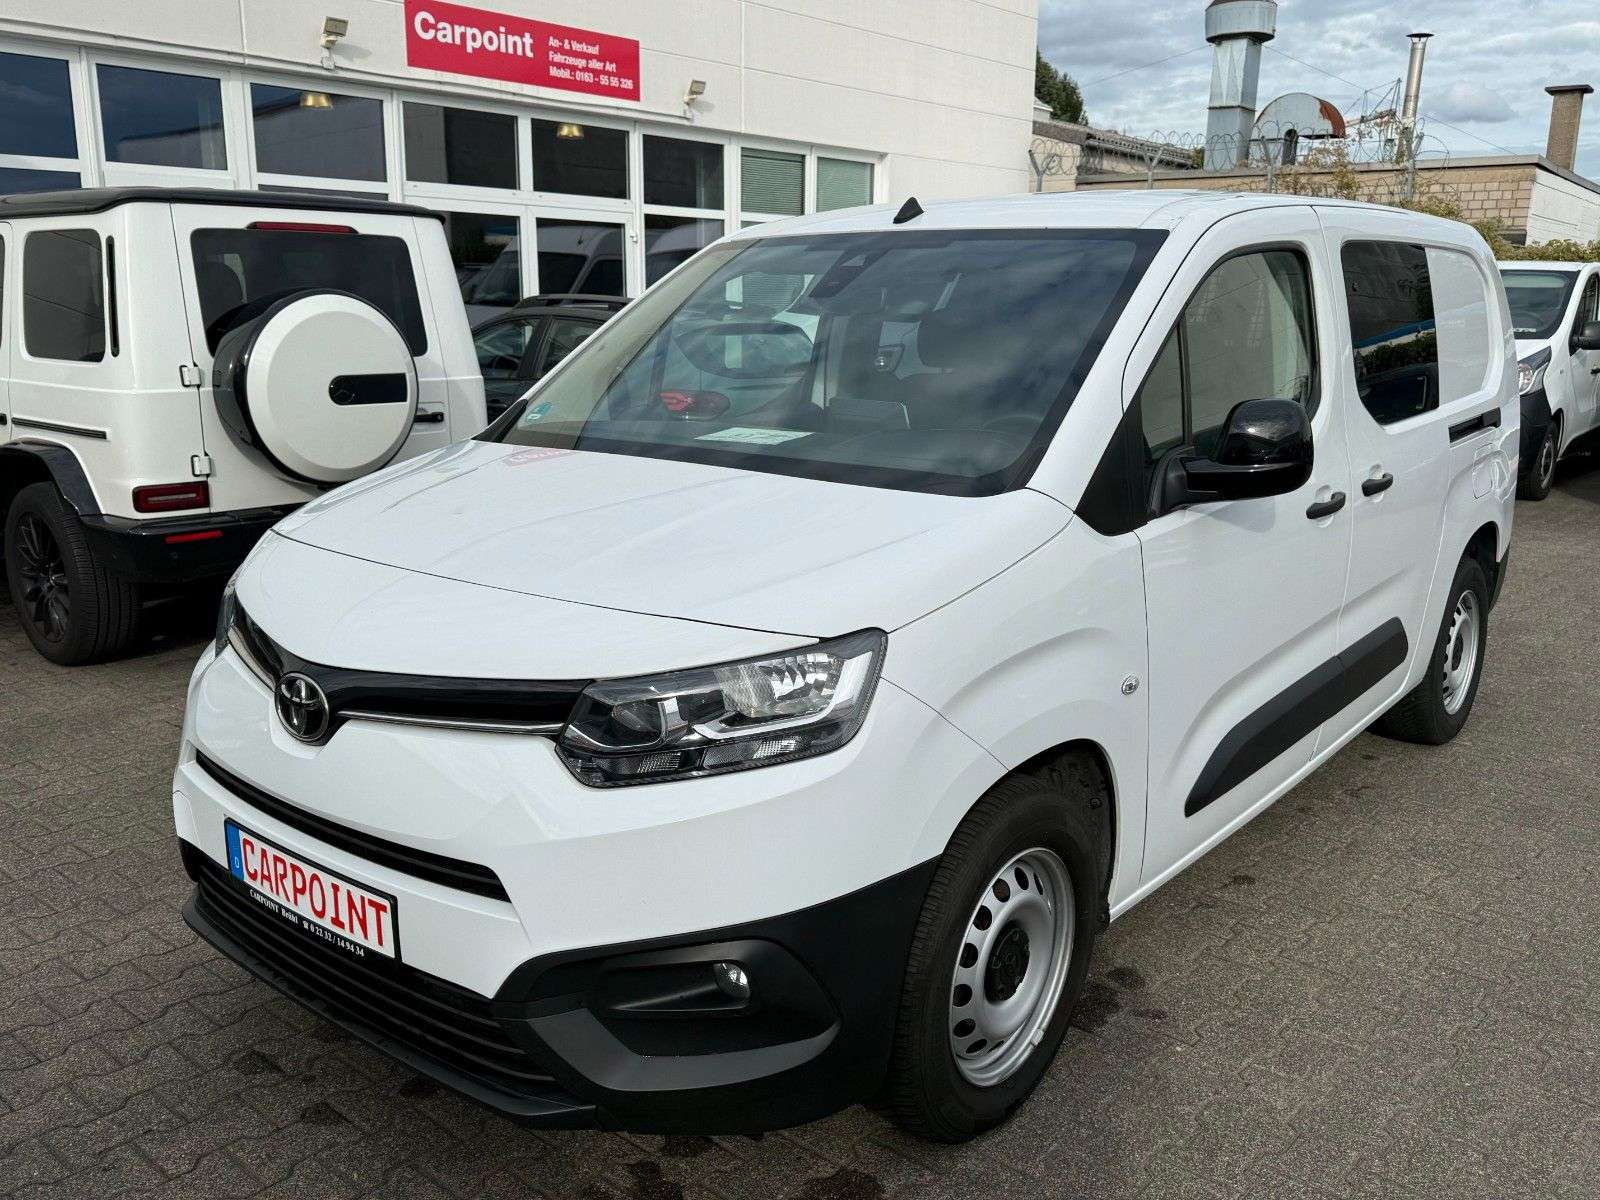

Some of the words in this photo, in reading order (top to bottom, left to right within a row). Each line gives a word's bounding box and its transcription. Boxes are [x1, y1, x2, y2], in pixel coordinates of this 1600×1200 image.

[414, 11, 534, 58] Carpoint
[549, 36, 562, 48] An-
[563, 39, 570, 50] &
[571, 40, 600, 55] Verkauf
[549, 51, 587, 69] Fahrzeuge
[588, 58, 604, 70] aller
[605, 61, 617, 72] Art
[242, 837, 388, 947] CARPOINT
[249, 889, 279, 914] CARPOINT
[281, 907, 299, 925] Brühl
